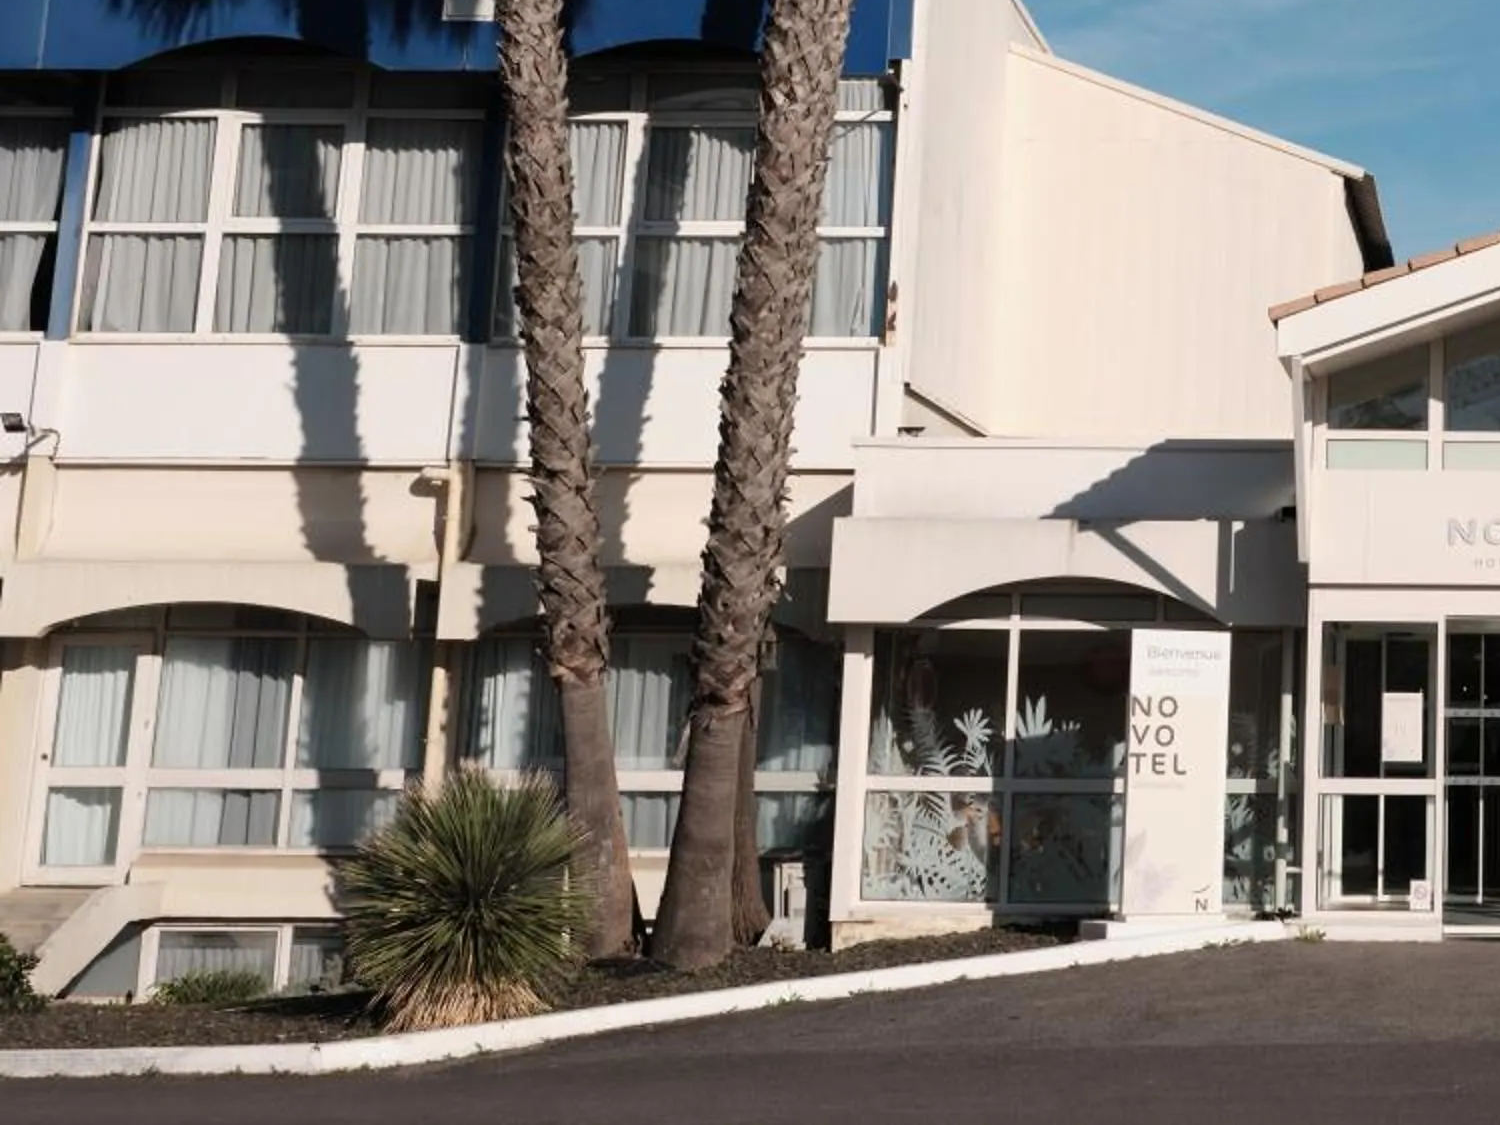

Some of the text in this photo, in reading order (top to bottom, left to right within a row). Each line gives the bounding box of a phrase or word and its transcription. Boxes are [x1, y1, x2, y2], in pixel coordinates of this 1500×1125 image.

[1131, 695, 1178, 718] NO
[1132, 724, 1175, 747] VO
[1129, 752, 1187, 775] TEL
